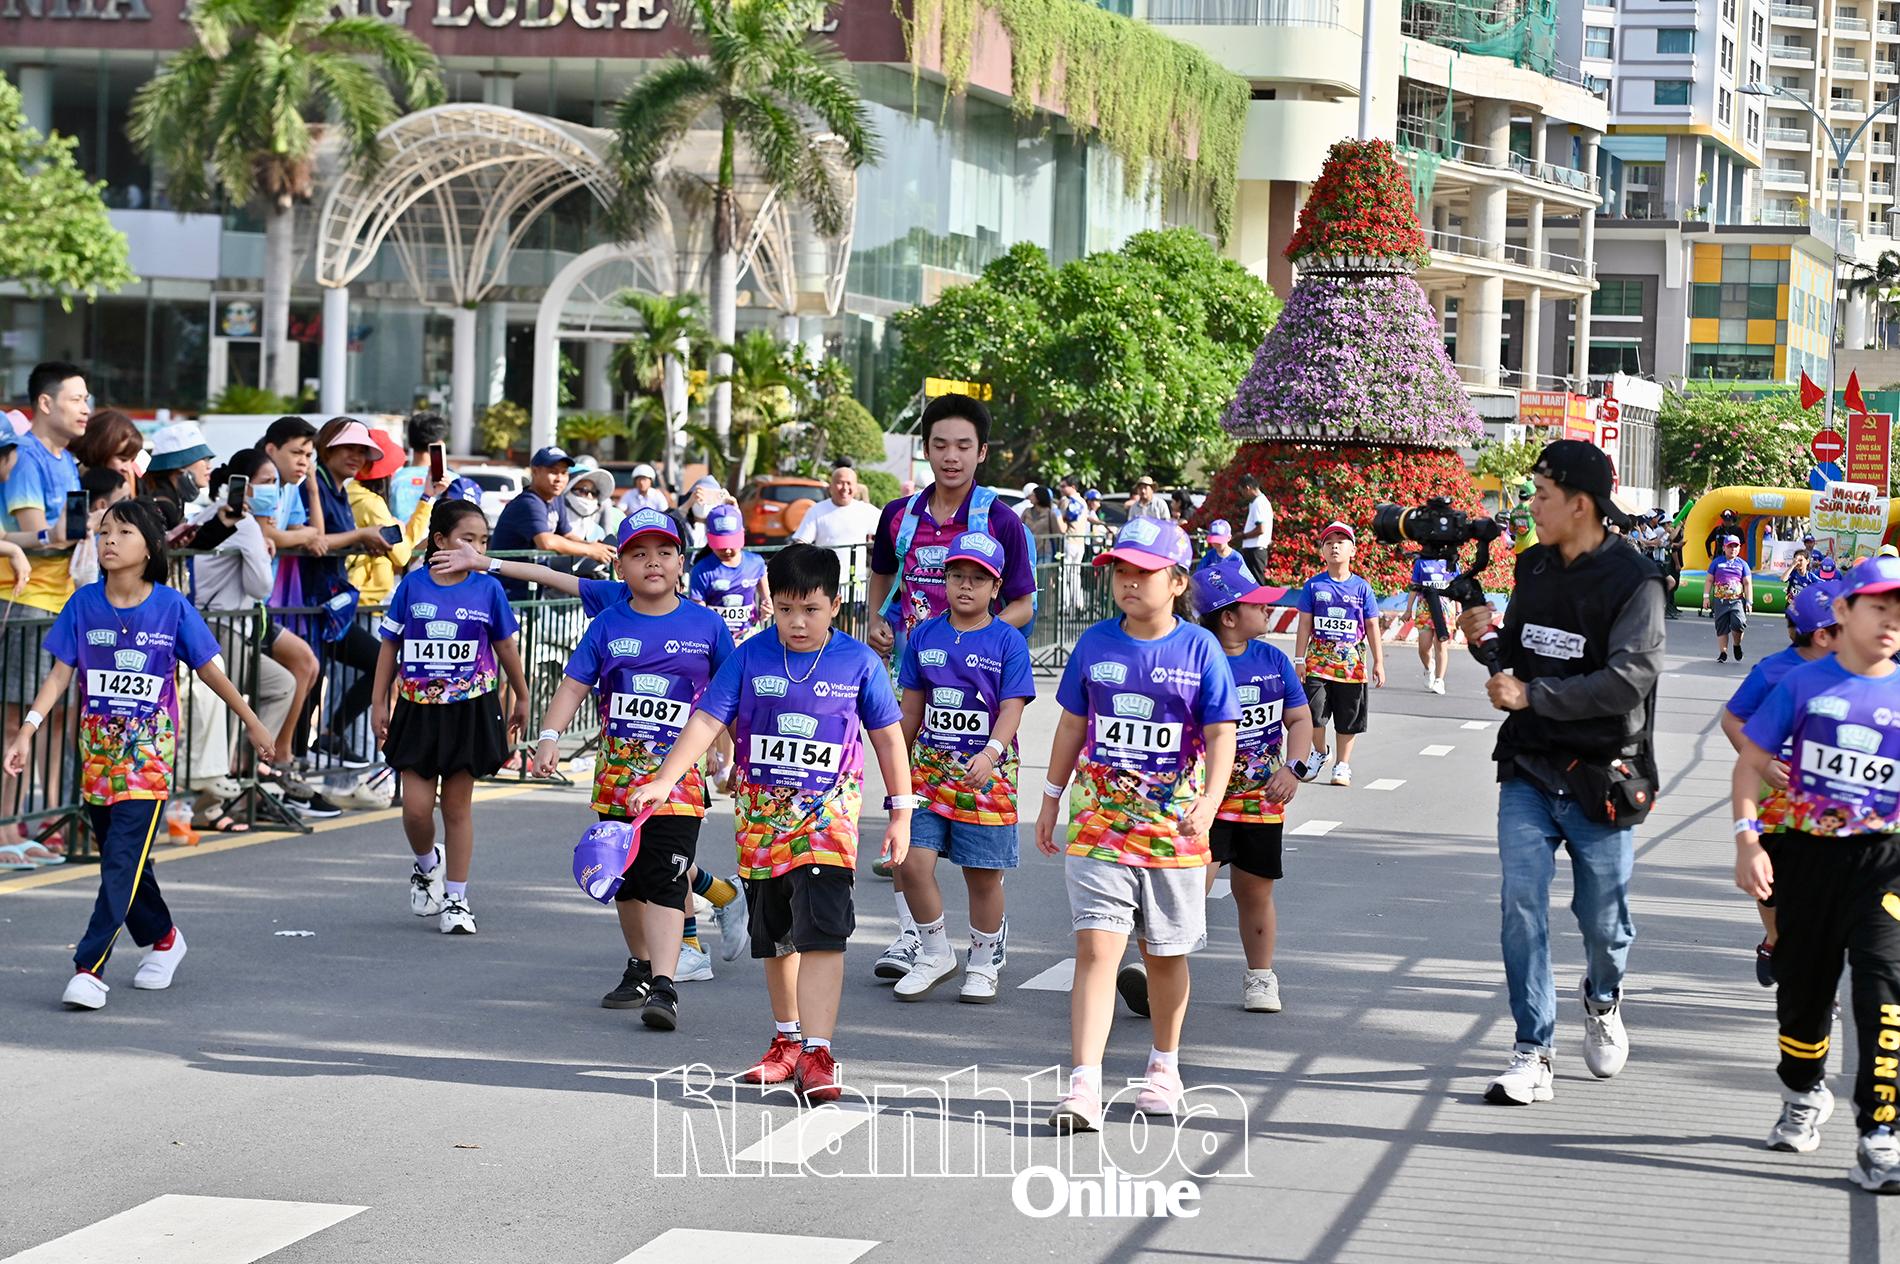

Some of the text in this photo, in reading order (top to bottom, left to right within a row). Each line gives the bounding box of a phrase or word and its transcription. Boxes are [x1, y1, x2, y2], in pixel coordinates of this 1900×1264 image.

[432, 0, 670, 30] LODGE
[1522, 394, 1565, 406] MINI MART
[713, 608, 750, 619] 403
[1319, 618, 1353, 630] 14354
[414, 643, 470, 659] 14108
[99, 673, 153, 697] 14235
[831, 682, 860, 691] VnExpre
[831, 690, 859, 698] Marath
[617, 696, 681, 722] 14087
[1100, 720, 1171, 748] 4110
[761, 738, 832, 767] 14154
[1816, 748, 1894, 784] 14169
[671, 853, 689, 882] 7
